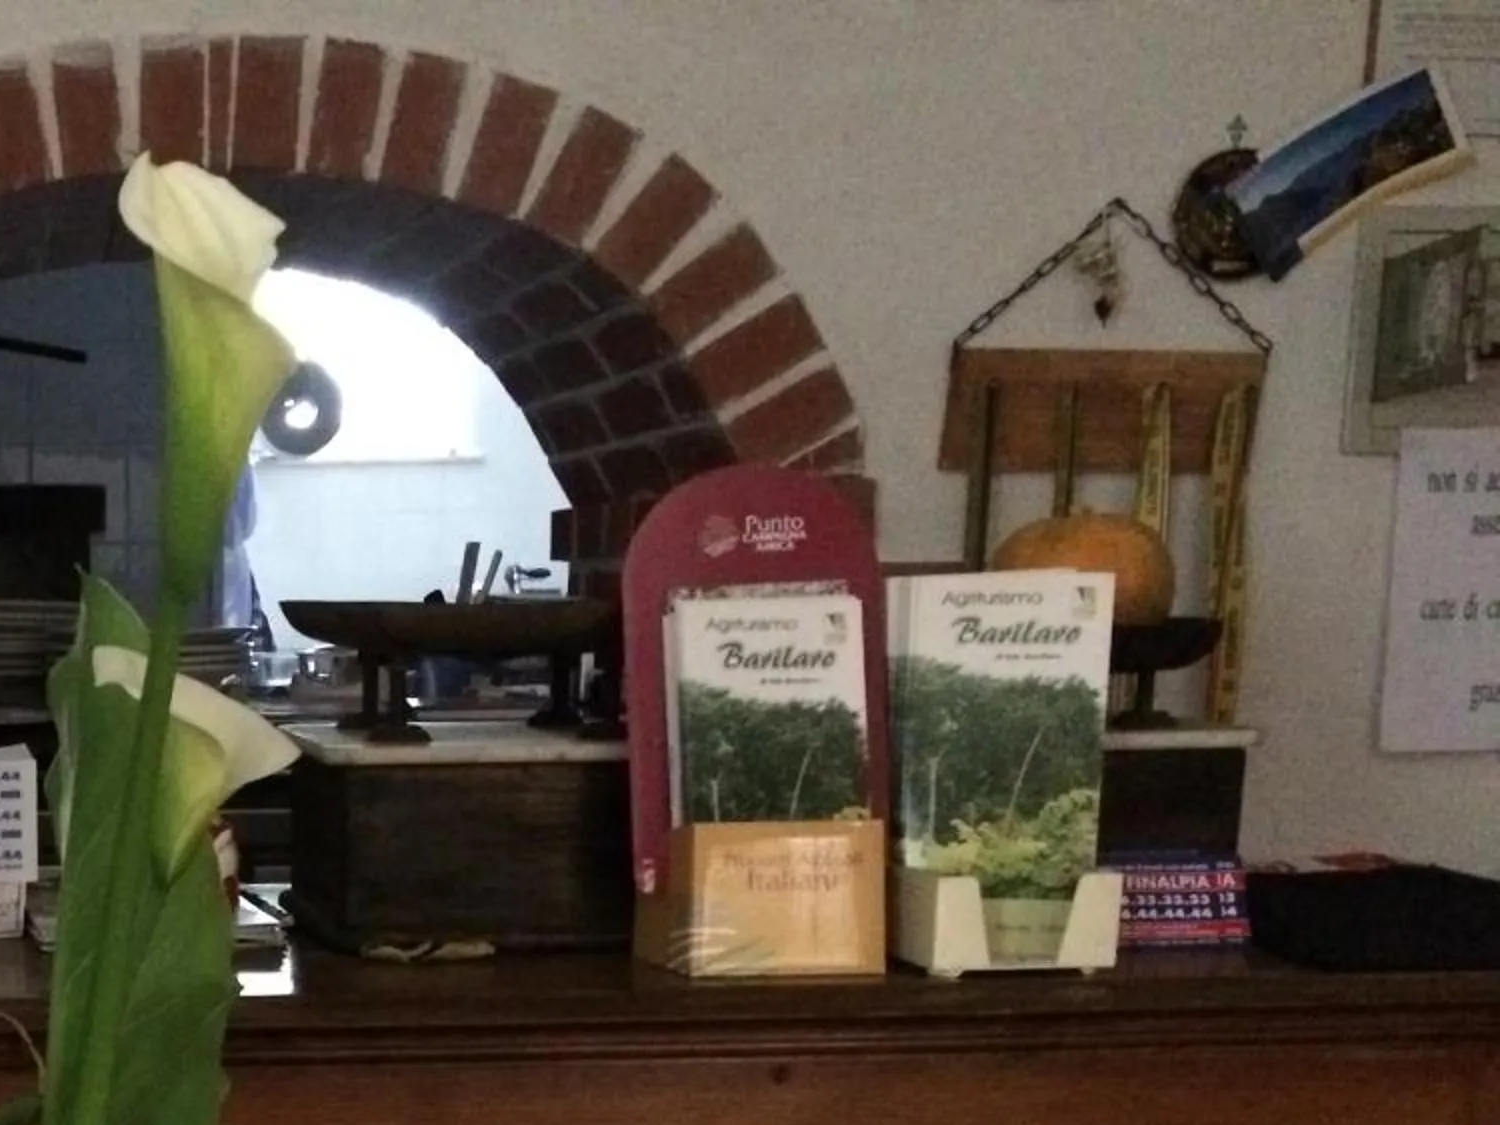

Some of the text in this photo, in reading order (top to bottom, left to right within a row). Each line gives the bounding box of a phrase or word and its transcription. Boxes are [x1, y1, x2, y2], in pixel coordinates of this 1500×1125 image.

[745, 515, 804, 531] Punto
[952, 616, 1082, 645] Barilaro
[717, 641, 836, 670] Barilaro
